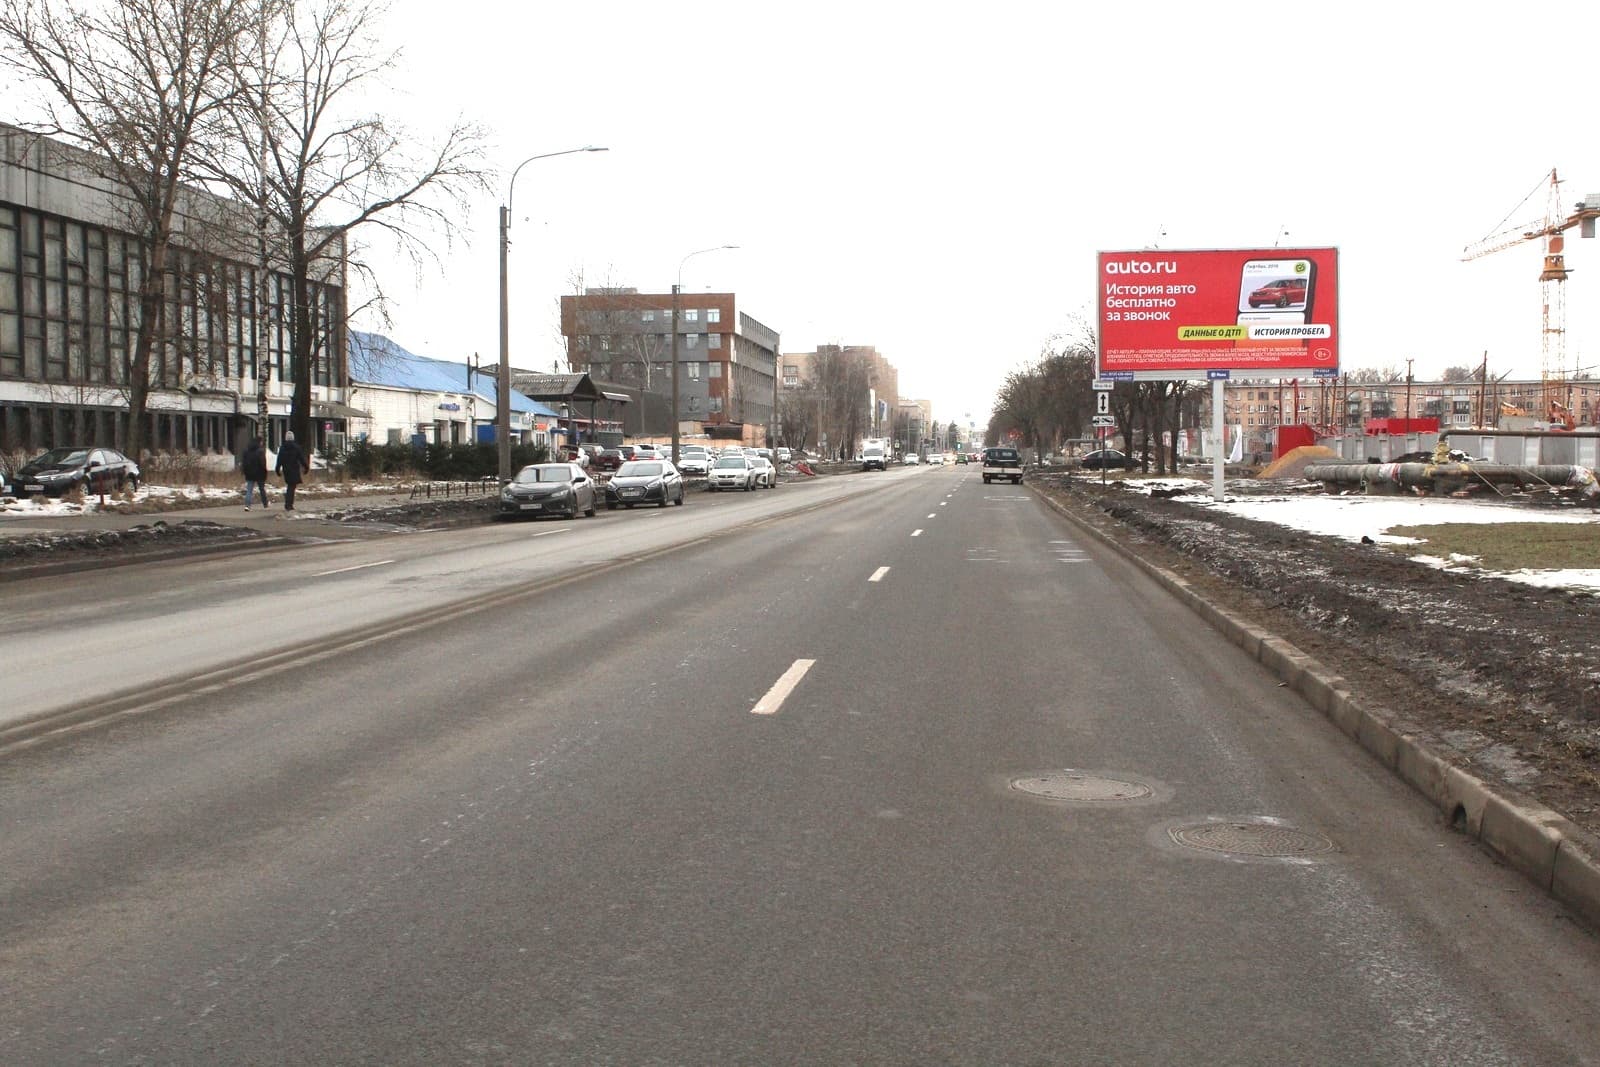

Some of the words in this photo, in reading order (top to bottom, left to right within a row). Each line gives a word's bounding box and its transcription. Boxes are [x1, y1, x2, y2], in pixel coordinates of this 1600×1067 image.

[1105, 260, 1177, 274] auto.ru
[1106, 283, 1163, 296] История
[1165, 284, 1196, 294] авто
[1106, 296, 1176, 308] бесплатно
[1106, 311, 1121, 321] за
[1123, 311, 1171, 321] звонок
[1183, 328, 1218, 338] ДАННЫЕ
[1219, 328, 1224, 337] О
[1225, 327, 1241, 338] ДТП
[1254, 327, 1290, 336] ИСТОРИЯ
[1291, 326, 1325, 335] ПРОБЕГА
